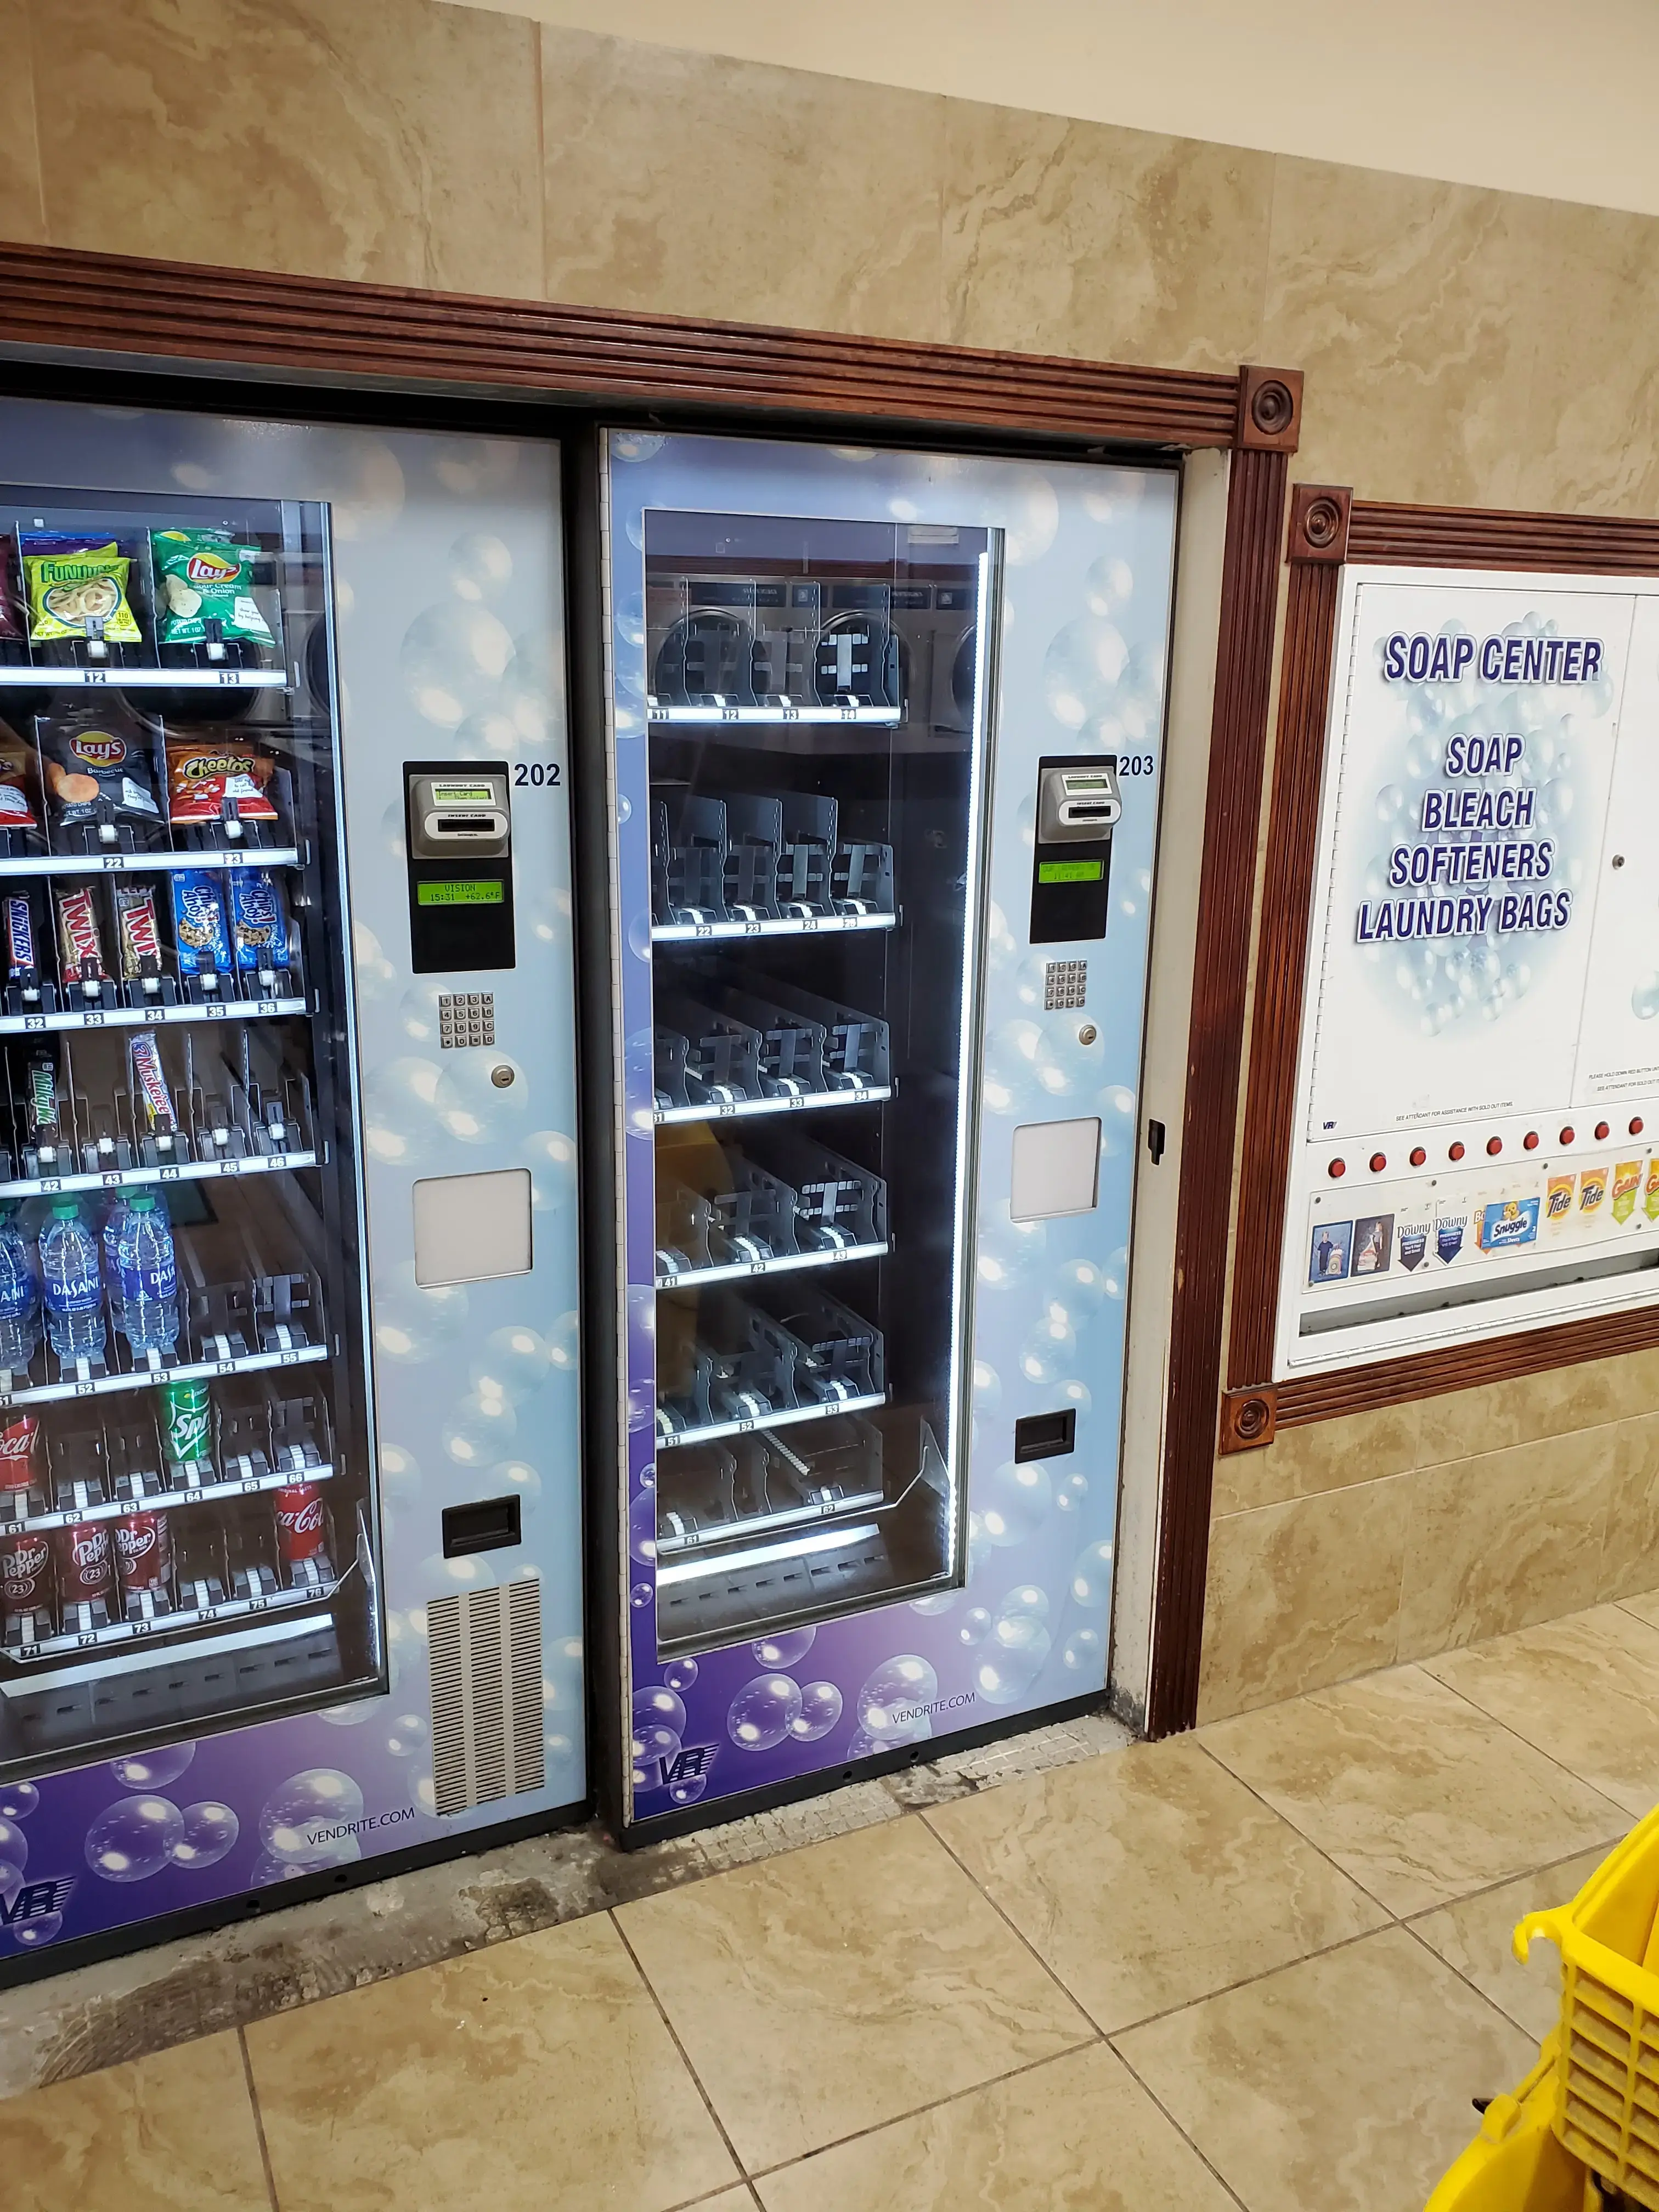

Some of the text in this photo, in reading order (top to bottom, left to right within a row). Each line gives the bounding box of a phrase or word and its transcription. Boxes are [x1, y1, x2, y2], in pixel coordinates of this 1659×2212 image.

[1386, 635, 1601, 681] SOAP CENTER
[87, 672, 103, 682] 12
[221, 673, 236, 684] 13
[656, 709, 855, 720] 11 12 13 14
[76, 740, 121, 760] Lay's
[1448, 736, 1522, 774] SOAP
[184, 757, 254, 779] Cheetos
[514, 763, 561, 786] 202
[1119, 755, 1154, 776] 203
[1424, 790, 1534, 828] BLEACH
[106, 854, 240, 868] 22 23
[1391, 841, 1553, 884] SOFTENERS
[430, 893, 454, 901] 15:31
[444, 884, 476, 892] VISION
[61, 889, 99, 958] TWIX
[698, 918, 856, 936] 22 23 24 25
[1358, 891, 1571, 940] LAUNDRY BAGS
[10, 900, 32, 964] SNICKERS
[27, 1003, 275, 1029] 32 33 34 35 36
[133, 1045, 148, 1057] 3
[721, 1105, 733, 1115] 32
[791, 1098, 803, 1107] 33
[856, 1092, 867, 1100] 34
[1405, 1112, 1431, 1120] ATTENDANT
[44, 1158, 284, 1190] 42 43 44 45 46
[1579, 1184, 1604, 1211] Tide
[1612, 1173, 1643, 1200] GAIN
[1547, 1192, 1572, 1218] Tide
[1397, 1223, 1431, 1238] Downy
[1435, 1216, 1468, 1230] Downy
[1493, 1217, 1527, 1238] Snuggle
[664, 1251, 846, 1286] 41 42 43
[53, 1278, 99, 1298] DASANI
[78, 1353, 297, 1393] 52 53 54 55
[668, 1404, 838, 1446] 51 52 53
[9, 1474, 302, 1533] 61 62 63 64 65 66
[120, 1528, 138, 1542] Dr
[687, 1536, 697, 1544] 61
[2, 1548, 47, 1578] Pepper
[16, 1547, 35, 1562] Dr
[89, 1568, 101, 1579] 23
[12, 1584, 24, 1594] 23
[24, 1588, 322, 1656] 71 72 73 74 75 76
[892, 1692, 975, 1724] VENDRITE.COM
[307, 1807, 415, 1845] VENDRITE.COM
